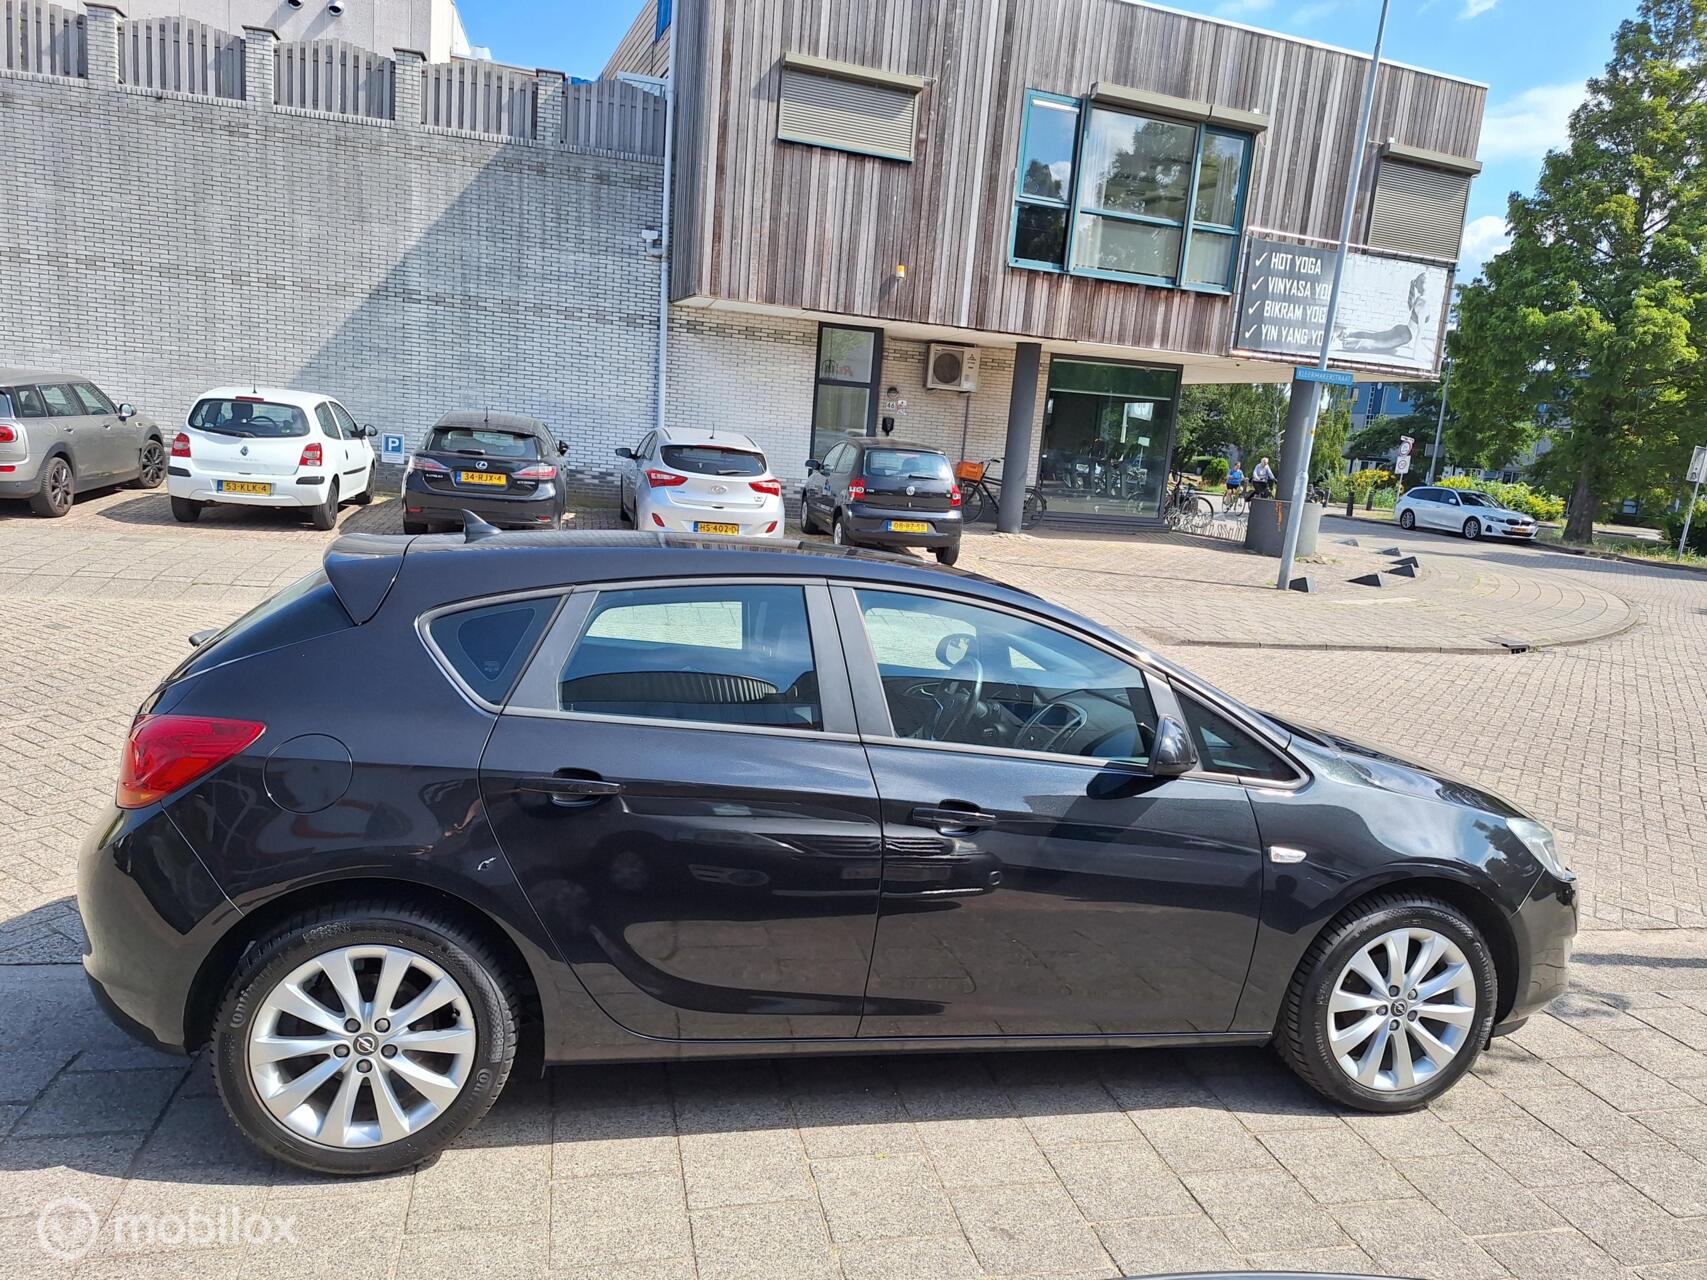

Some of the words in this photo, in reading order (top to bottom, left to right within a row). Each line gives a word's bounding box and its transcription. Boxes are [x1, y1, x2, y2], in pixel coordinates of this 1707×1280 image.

[1270, 252, 1293, 271] HOT
[1294, 255, 1322, 275] YOGA
[1268, 276, 1311, 298] VINYASA
[1315, 282, 1332, 300] YO
[1263, 300, 1303, 320] BIKRAM
[1306, 305, 1327, 323] YOG
[1261, 323, 1278, 341] YIN
[1281, 326, 1308, 344] YANG
[1311, 329, 1325, 346] YO
[388, 437, 400, 451] P
[464, 472, 502, 483] 34-RJX-4
[225, 482, 268, 493] 53-KLK-4
[699, 523, 738, 535] HS-402-D
